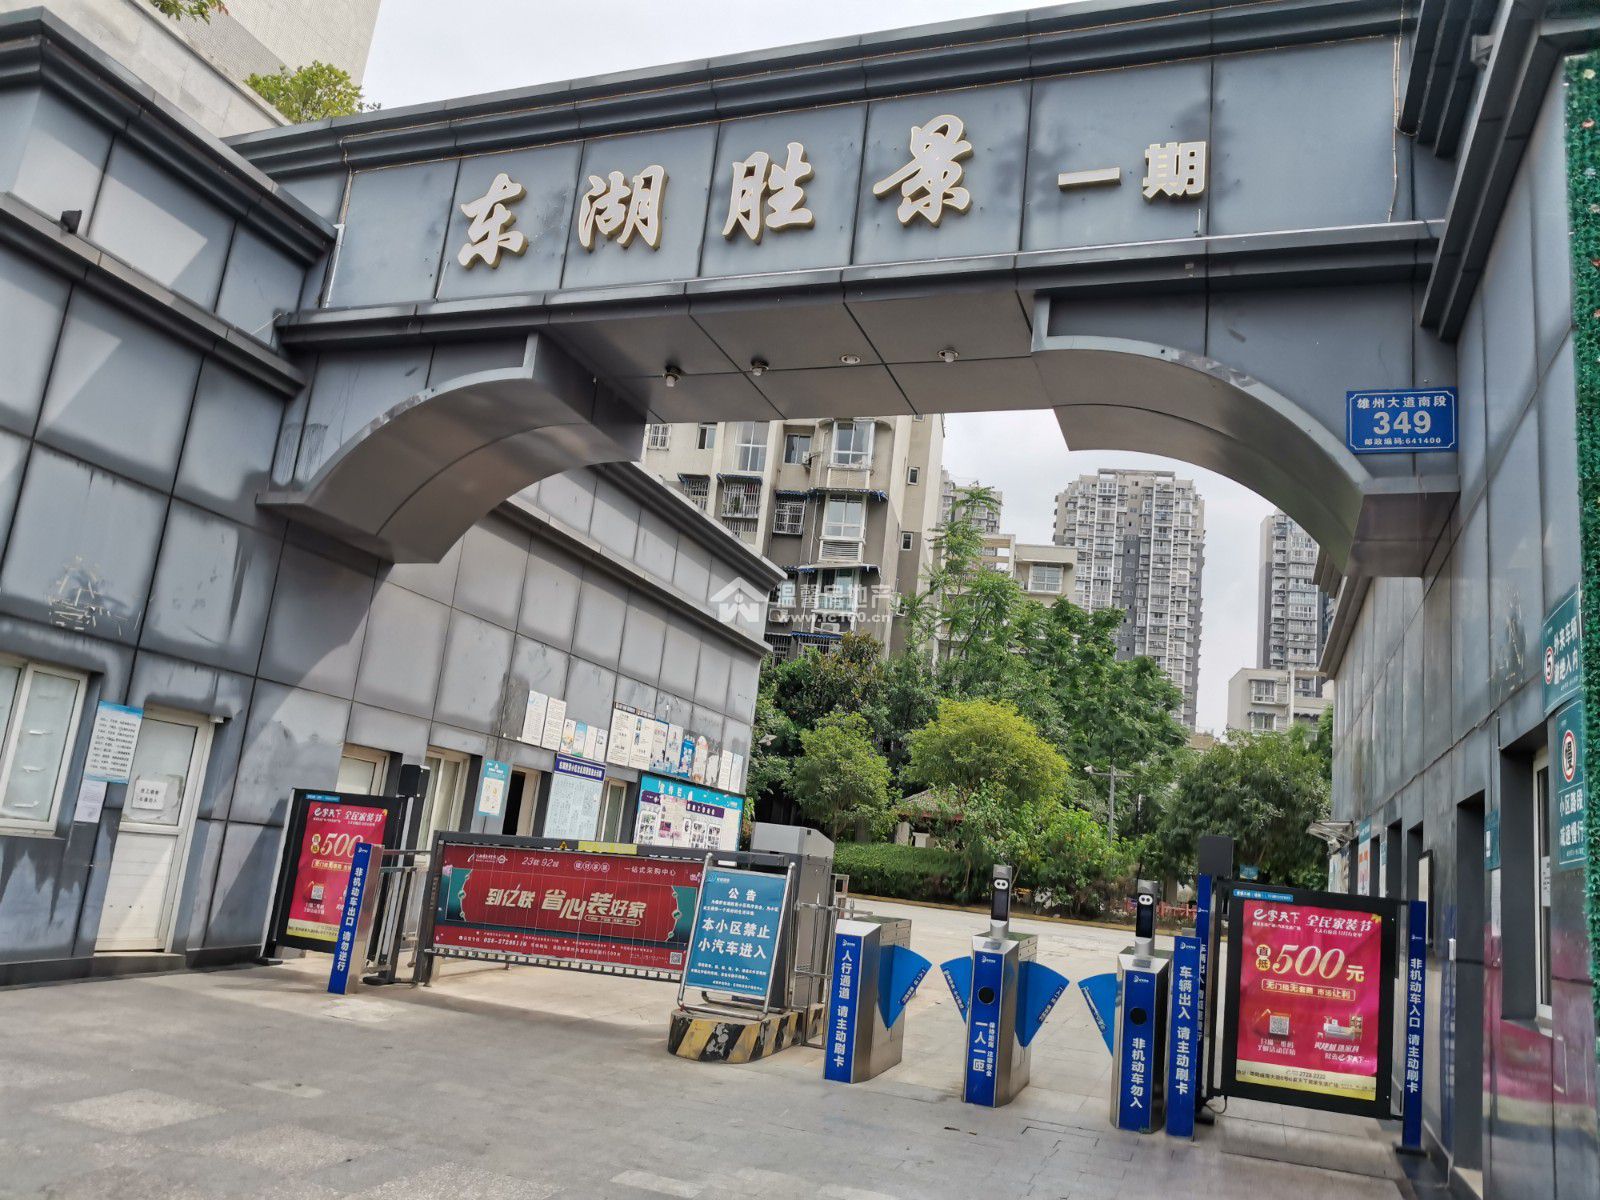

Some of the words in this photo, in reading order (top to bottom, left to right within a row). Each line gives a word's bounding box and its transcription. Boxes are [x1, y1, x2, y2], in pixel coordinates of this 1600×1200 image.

[458, 114, 973, 269] 东湖胜景
[1058, 141, 1207, 200] 一期
[1356, 395, 1447, 410] 雄州大道南段
[1373, 411, 1431, 435] 349
[345, 867, 364, 927] 非机动车出口
[485, 884, 536, 909] 到亿联
[541, 889, 647, 920] 省心装好家
[728, 887, 757, 902] 公告
[702, 917, 771, 939] 本小区禁止
[1306, 914, 1373, 932] 全民家装节
[698, 938, 767, 960] 小汽车进入
[1256, 944, 1270, 970] 直抵
[1272, 944, 1365, 983] 500元
[838, 950, 853, 1000] 人行通道
[1177, 965, 1194, 1020] 车辆出入
[1409, 958, 1423, 1028] 非机动车入口
[833, 1005, 849, 1068] 请主动刷卡
[1129, 1037, 1146, 1109] 非机动车勿入
[1175, 1026, 1191, 1096] 请主动刷卡
[1406, 1034, 1421, 1094] 请主动刷卡
